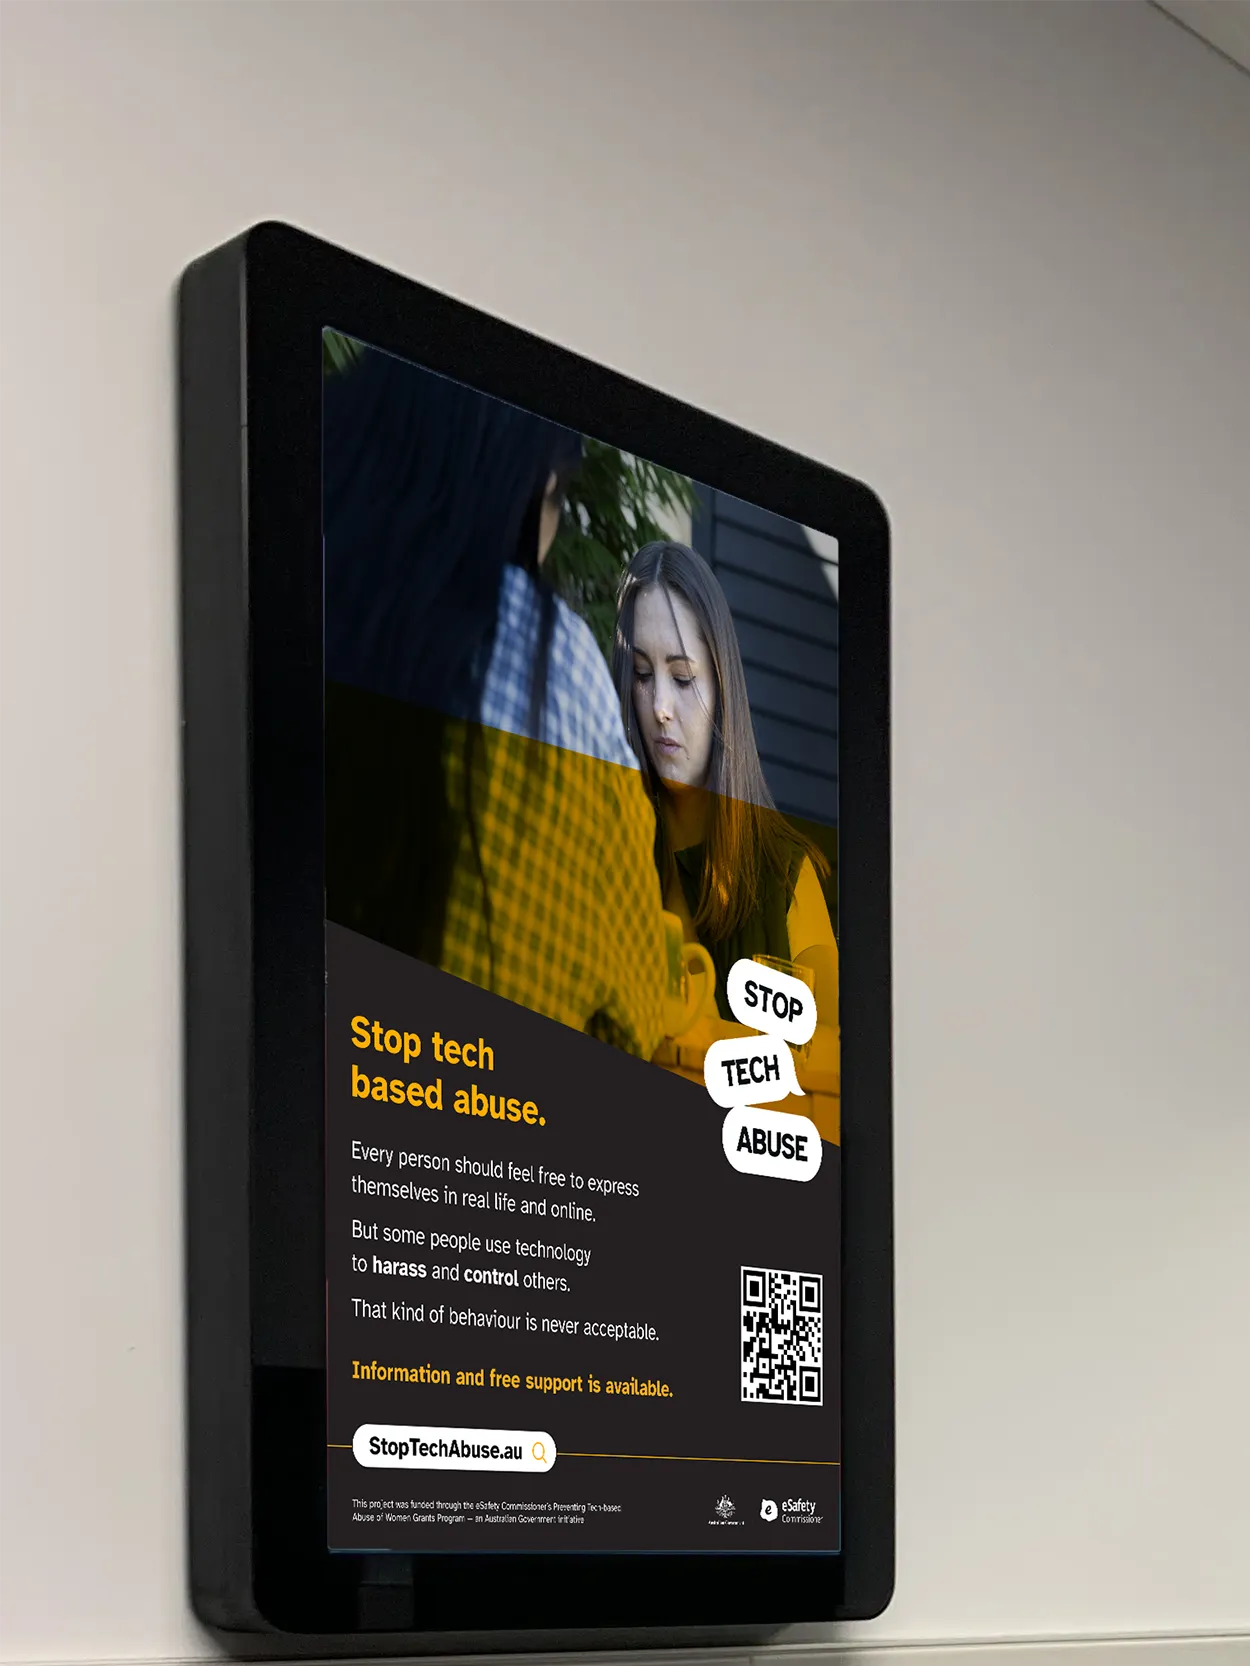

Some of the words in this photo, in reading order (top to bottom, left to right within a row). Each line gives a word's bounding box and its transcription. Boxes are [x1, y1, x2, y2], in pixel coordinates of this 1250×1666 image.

[744, 979, 804, 1023] STOP
[351, 1015, 422, 1064] Stop
[432, 1031, 495, 1071] tech
[721, 1054, 781, 1087] TECH
[352, 1064, 444, 1111] based
[453, 1083, 547, 1127] abuse.
[736, 1125, 809, 1163] ABUSE
[352, 1140, 394, 1168] Every
[399, 1151, 450, 1173] person
[455, 1159, 504, 1179] should
[508, 1162, 535, 1183] feel
[539, 1166, 566, 1187] free
[570, 1173, 585, 1190] to
[588, 1178, 640, 1198] express
[352, 1175, 440, 1203] themselves
[443, 1185, 458, 1205] in
[463, 1192, 491, 1210] real
[495, 1192, 516, 1213] life
[521, 1199, 547, 1216] and
[551, 1202, 596, 1223] online.
[352, 1220, 379, 1241] But
[383, 1228, 426, 1246] some
[431, 1233, 482, 1255] people
[486, 1239, 511, 1255] use
[516, 1239, 592, 1267] technology
[352, 1254, 368, 1273] to
[372, 1255, 428, 1279] harass
[432, 1264, 460, 1282] and
[464, 1269, 520, 1288] control
[523, 1272, 571, 1292] others.
[351, 1298, 387, 1320] That
[391, 1301, 425, 1323] kind
[430, 1305, 445, 1324] of
[449, 1307, 522, 1331] behaviour
[526, 1312, 538, 1332] is
[542, 1319, 580, 1335] never
[584, 1322, 660, 1342] acceptable.
[352, 1361, 451, 1385] Information
[456, 1368, 485, 1387] and
[490, 1368, 521, 1389] free
[526, 1375, 583, 1395] support
[588, 1374, 602, 1394] is
[606, 1377, 674, 1398] available.
[369, 1436, 523, 1460] StopTechAbuse.au
[352, 1499, 368, 1509] This
[369, 1500, 395, 1510] project
[411, 1500, 435, 1510] funded
[436, 1501, 462, 1512] through
[463, 1502, 474, 1510] the
[475, 1501, 500, 1512] eSafety
[352, 1513, 375, 1522] Abuse
[376, 1513, 384, 1522] of
[385, 1513, 411, 1522] Women
[412, 1513, 436, 1523] Grants
[437, 1513, 465, 1525] Program
[781, 1498, 816, 1515] eSafety
